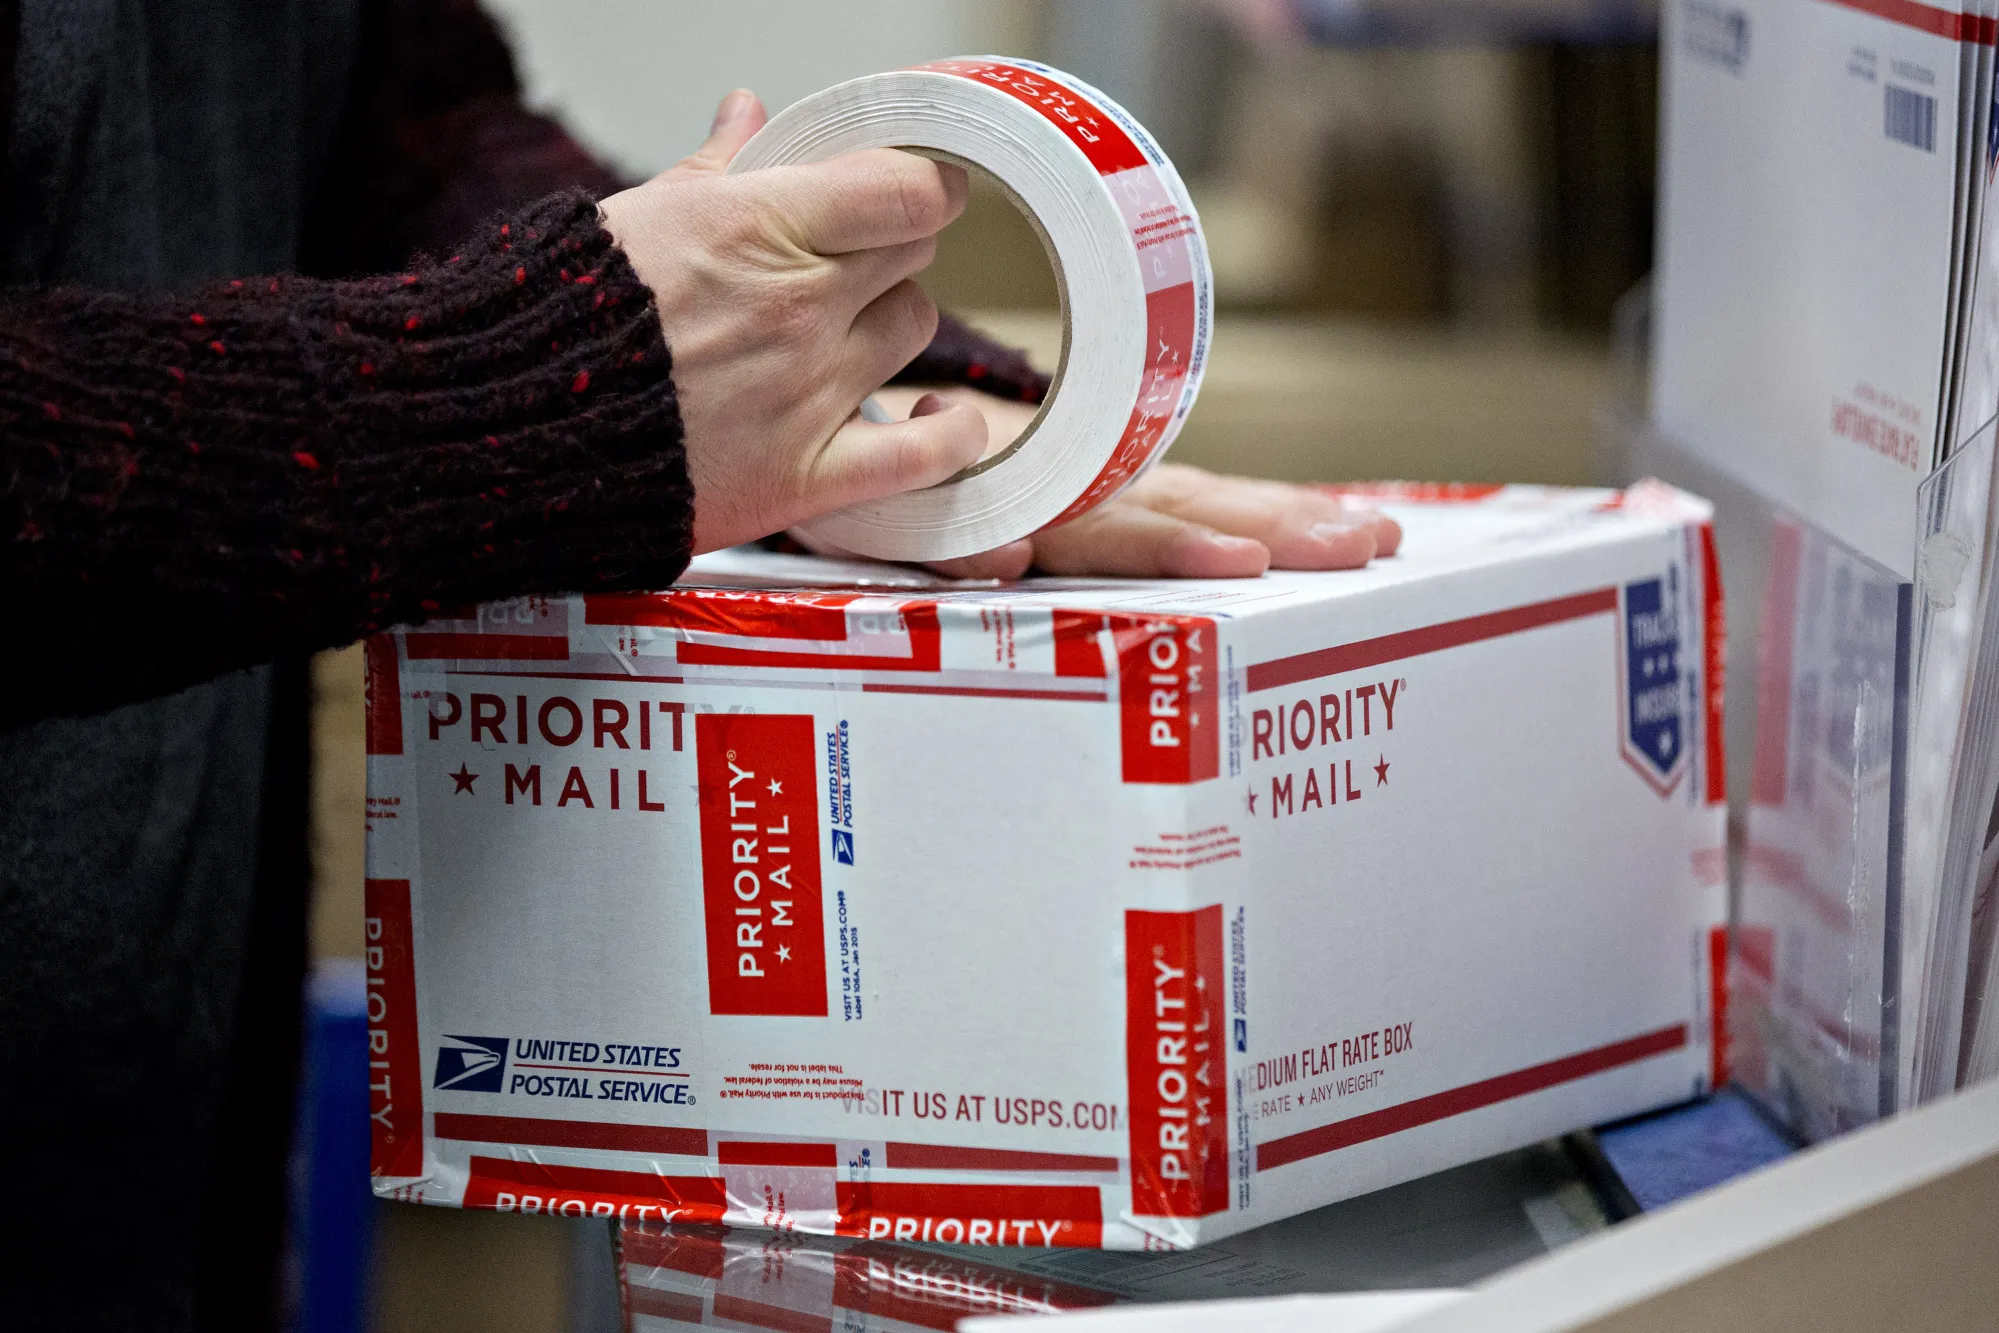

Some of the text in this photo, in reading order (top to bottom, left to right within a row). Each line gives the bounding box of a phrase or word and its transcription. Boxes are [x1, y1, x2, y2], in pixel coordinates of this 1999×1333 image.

[827, 732, 841, 824] UNITED STATES
[503, 762, 665, 813] MAIL
[1271, 759, 1362, 819] MAIL
[840, 782, 853, 828] POSTAL
[766, 814, 794, 927] MAIL
[515, 1038, 682, 1068] UNITED STATES
[1302, 1042, 1338, 1079] FLAT
[1341, 1031, 1379, 1068] RATE
[1384, 1021, 1413, 1057] BOX
[773, 1064, 785, 1073] for
[786, 1064, 799, 1073] not
[800, 1064, 807, 1073] is
[809, 1064, 827, 1073] label
[828, 1064, 844, 1074] This
[1193, 1007, 1212, 1127] MAIL
[510, 1074, 594, 1099] POSTAL
[738, 1077, 763, 1086] federal
[764, 1078, 772, 1086] of
[773, 1078, 804, 1087] violation
[812, 1078, 821, 1087] be
[823, 1077, 837, 1086] may
[839, 1079, 863, 1088] Misuse
[913, 1091, 948, 1119] US
[955, 1094, 986, 1123] AT
[1261, 1094, 1291, 1119] RATE
[1310, 1082, 1334, 1105] ANY
